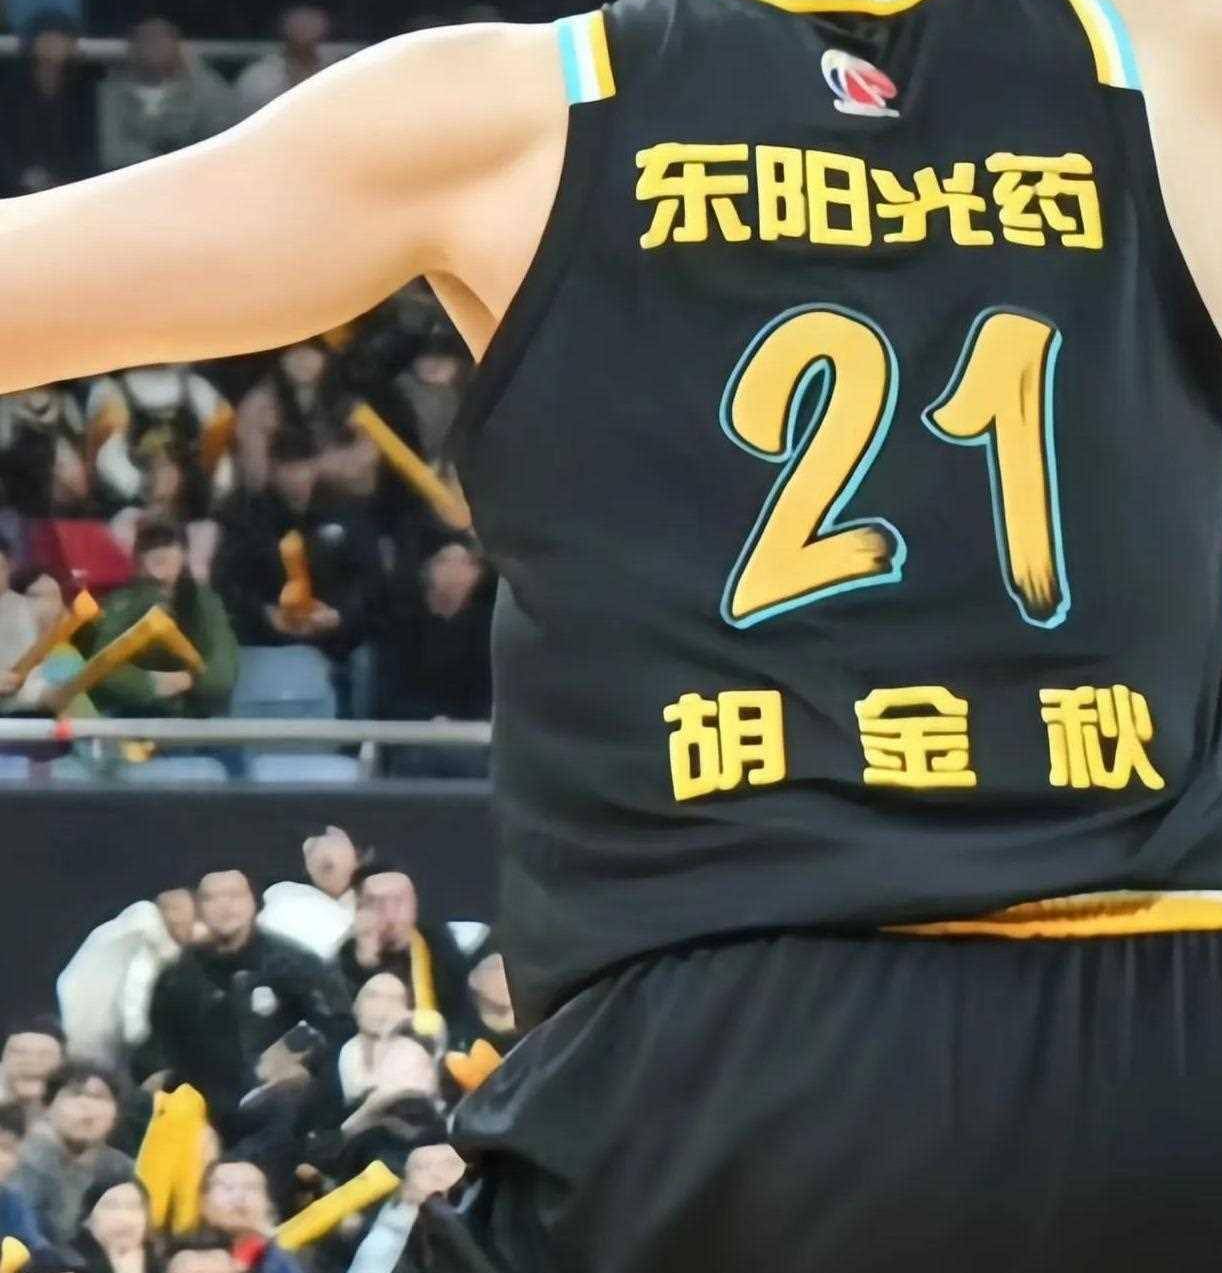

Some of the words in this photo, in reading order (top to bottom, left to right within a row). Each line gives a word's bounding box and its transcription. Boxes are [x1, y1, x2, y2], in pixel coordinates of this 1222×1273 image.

[635, 142, 1104, 250] 东阳光药
[719, 302, 1072, 629] 21
